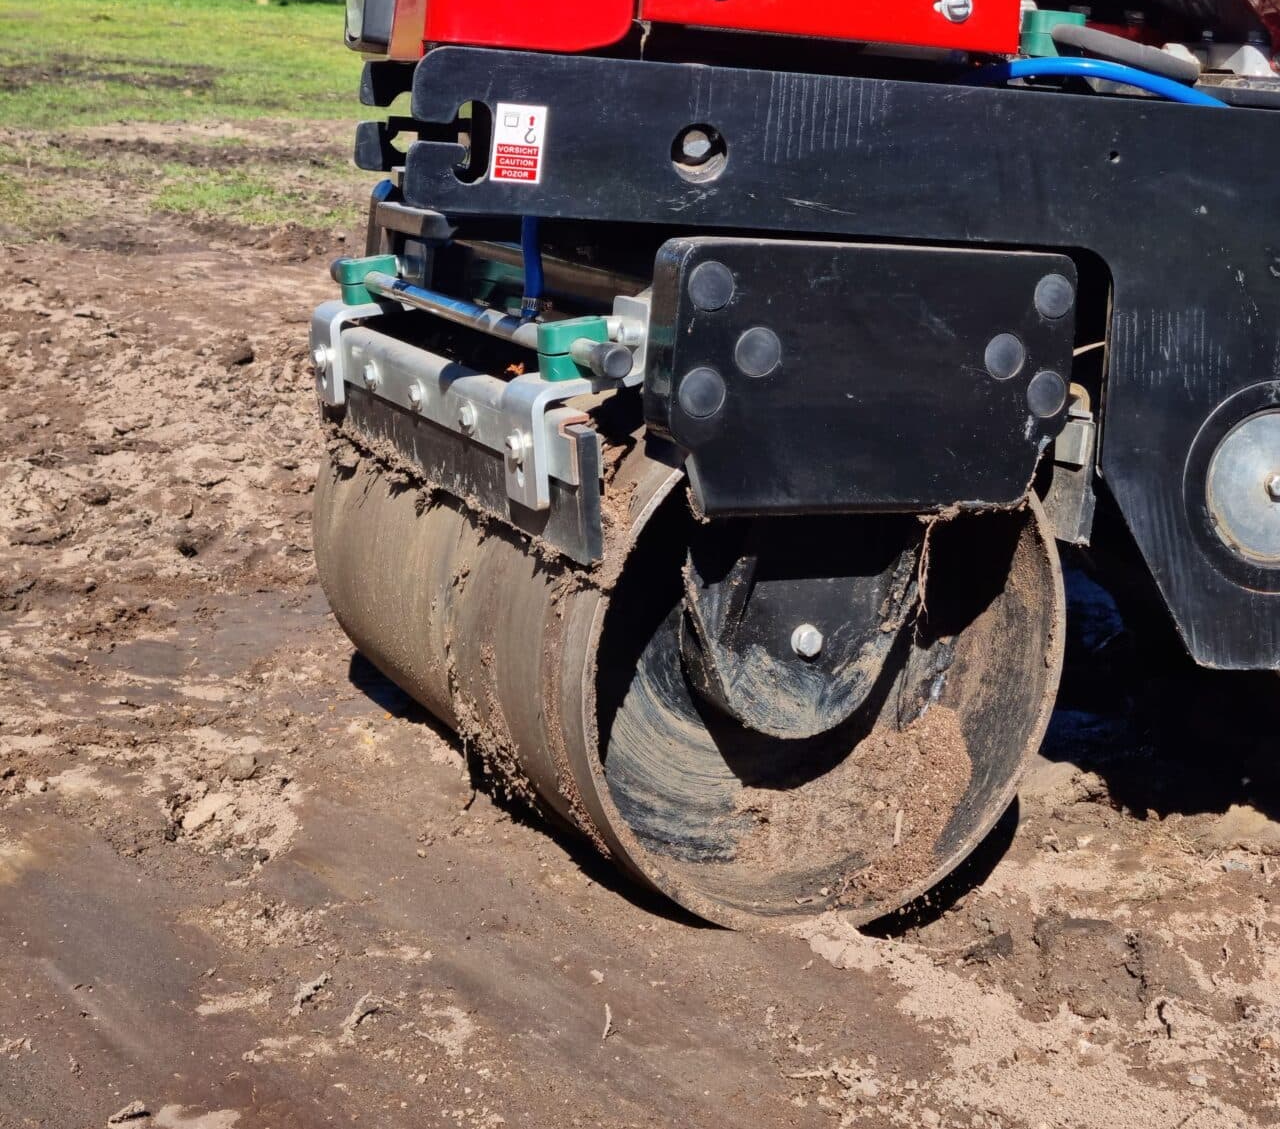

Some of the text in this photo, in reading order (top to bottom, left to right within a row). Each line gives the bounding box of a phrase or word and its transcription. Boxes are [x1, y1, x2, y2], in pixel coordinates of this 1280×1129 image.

[498, 145, 539, 155] VORSICHT
[499, 157, 535, 167] CAUTION
[501, 170, 529, 178] POZOR
